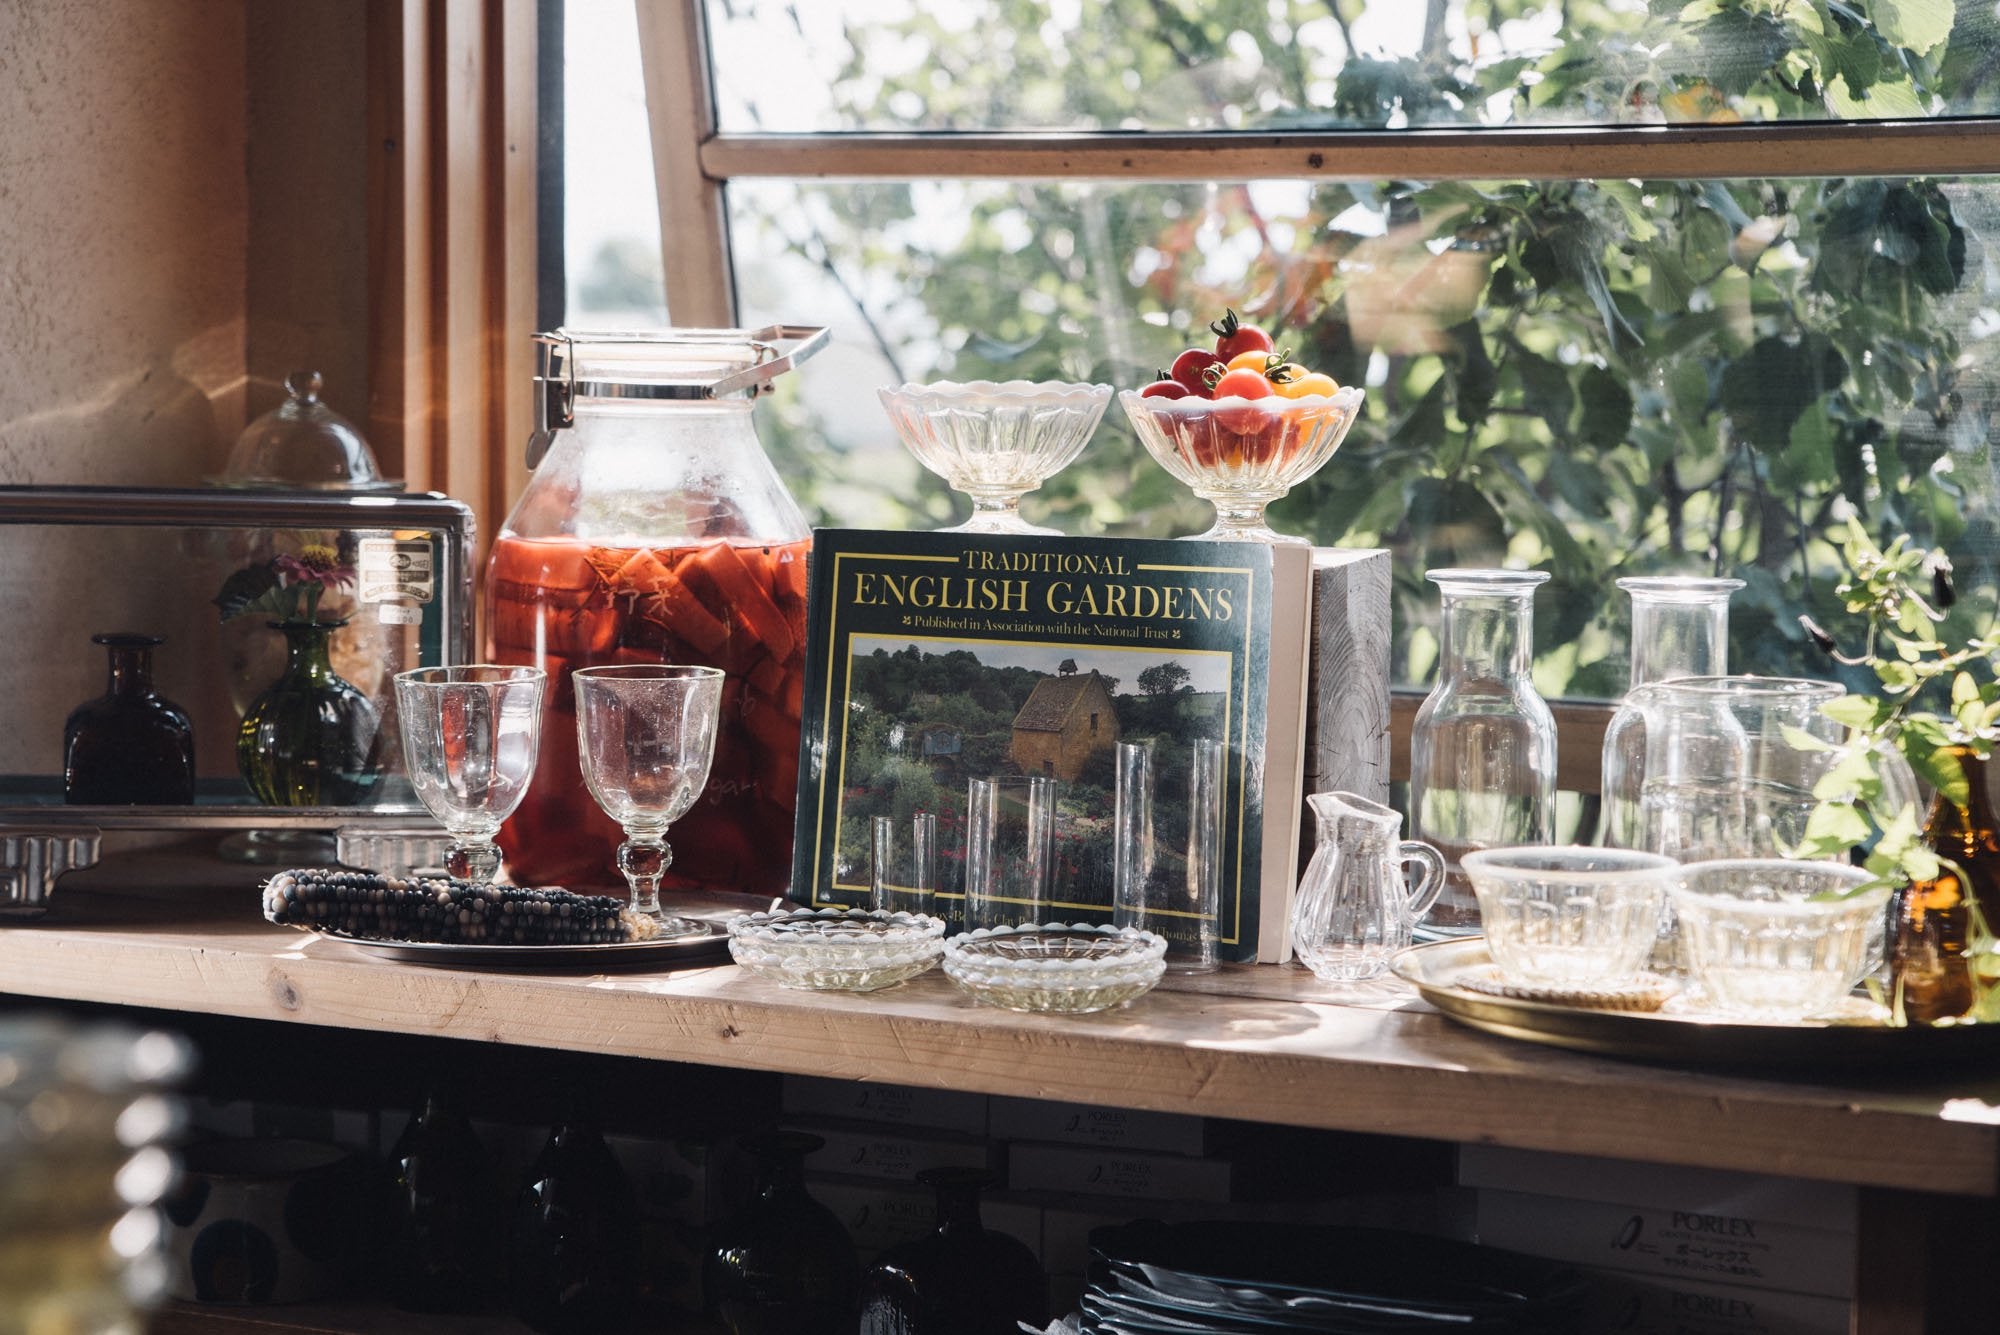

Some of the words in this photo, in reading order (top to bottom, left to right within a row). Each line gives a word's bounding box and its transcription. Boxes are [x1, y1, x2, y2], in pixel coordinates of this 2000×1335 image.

[963, 550, 1131, 576] TRADITIONAL
[853, 572, 1030, 612] ENGLISH
[1046, 581, 1233, 622] GARDENS
[914, 615, 967, 629] Published
[969, 618, 981, 630] in
[983, 619, 1045, 634] Association
[1046, 622, 1072, 635] with
[1073, 625, 1091, 636] the
[1093, 624, 1140, 638] National
[1142, 626, 1169, 640] Trust
[1672, 1211, 1756, 1239] PORLEX
[1670, 1294, 1755, 1320] PORLEX
